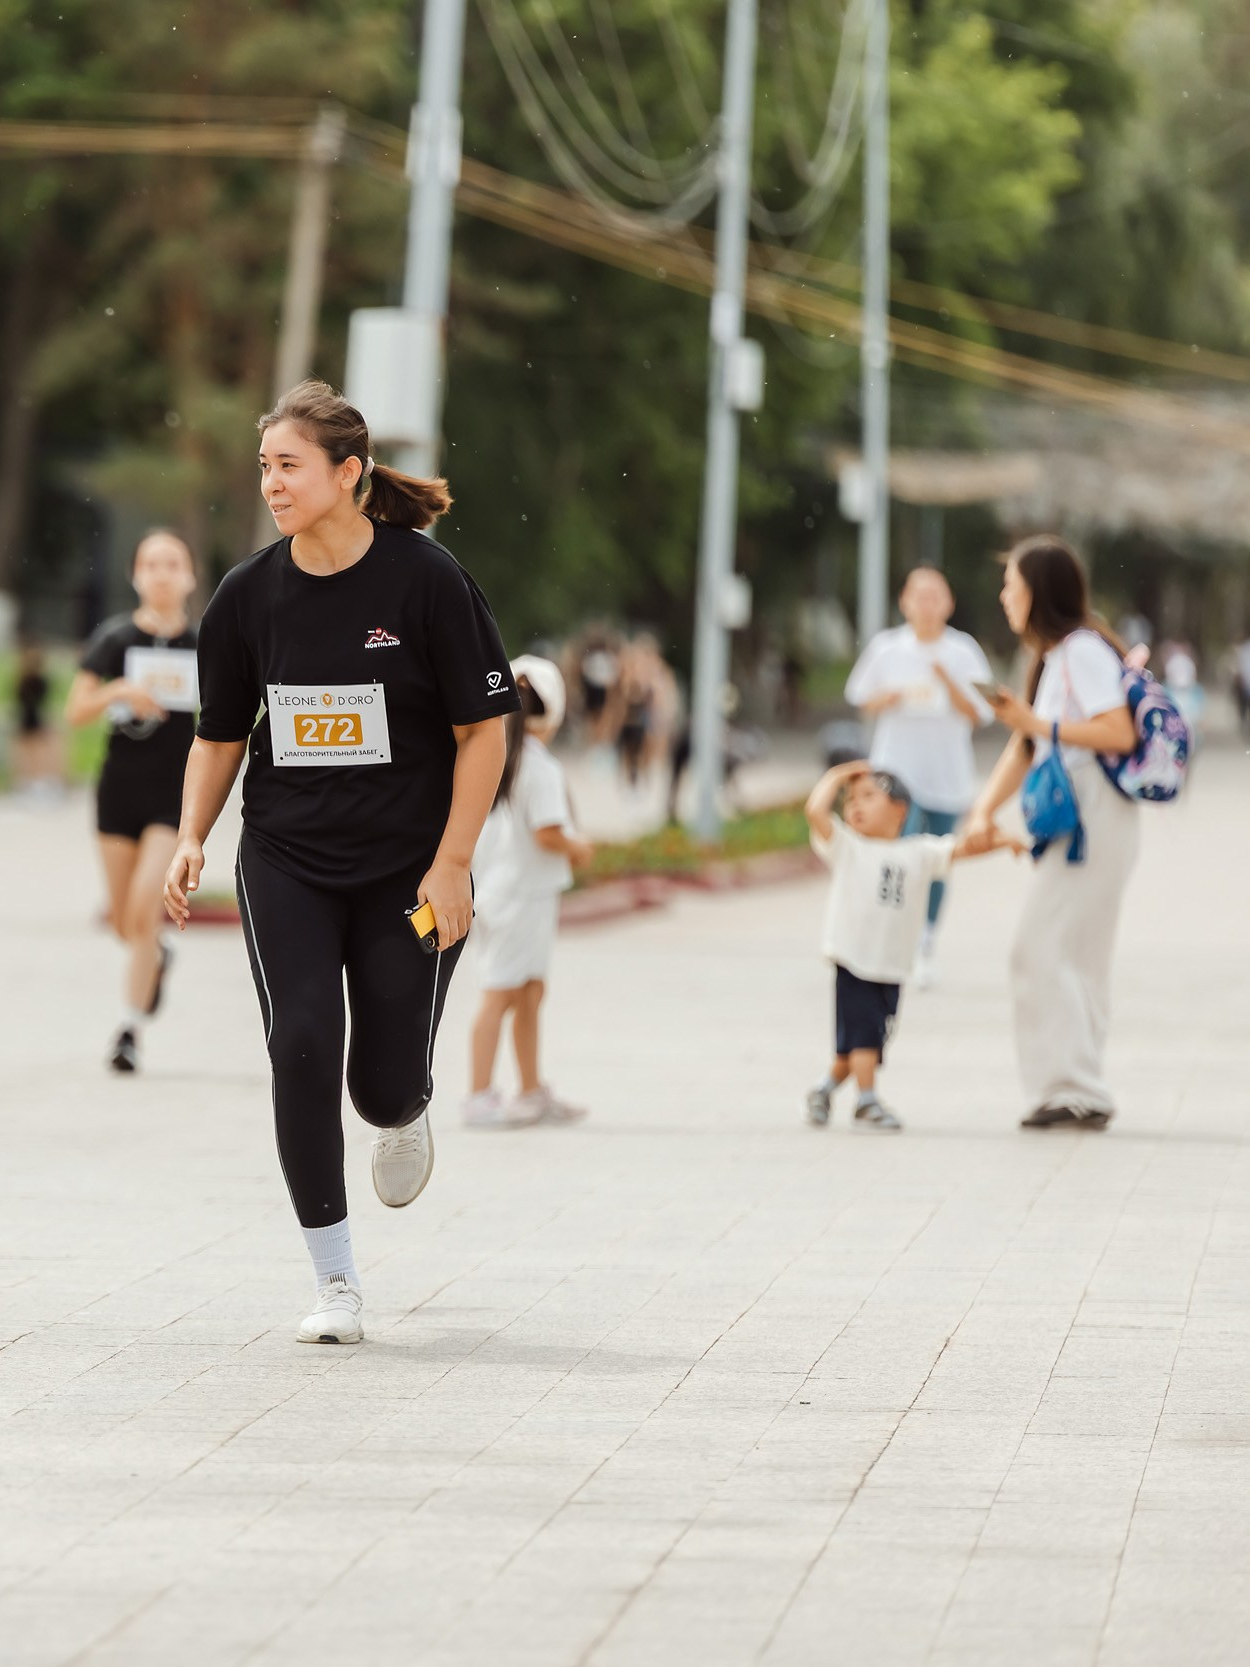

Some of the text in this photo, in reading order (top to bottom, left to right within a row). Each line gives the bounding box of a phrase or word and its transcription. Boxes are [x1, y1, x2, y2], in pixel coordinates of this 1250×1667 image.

[364, 640, 401, 649] NORTHLAND
[277, 696, 317, 706] LEONE
[301, 717, 356, 743] 272
[284, 748, 378, 757] БЛАГОТВОРИТЕЛЬНЫЙ ЗАБЕГ
